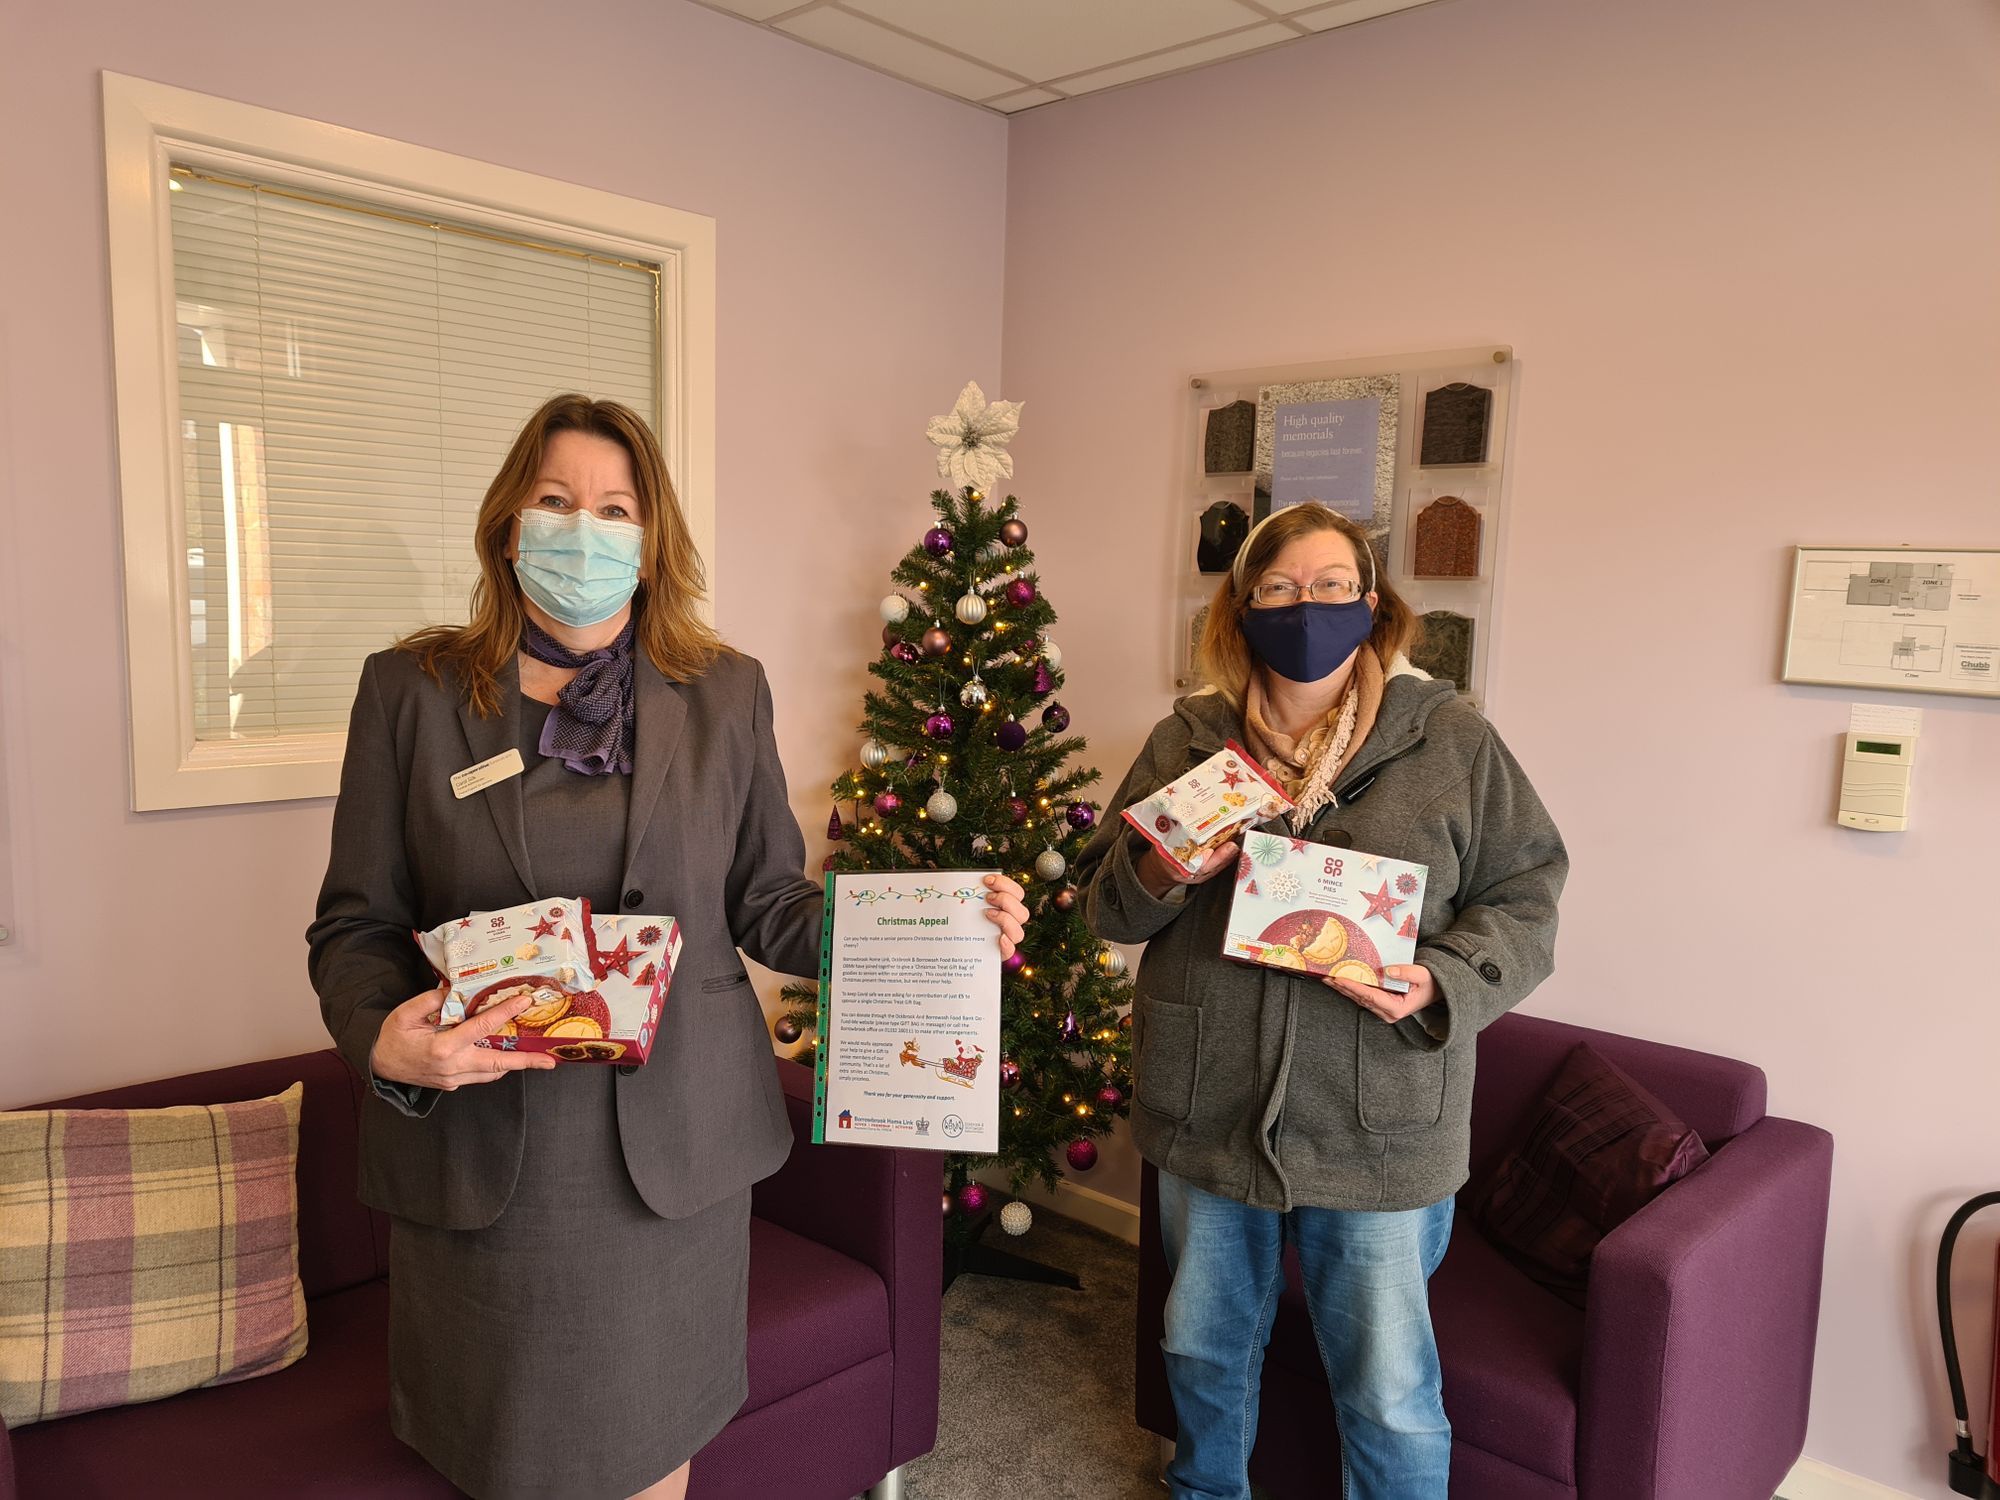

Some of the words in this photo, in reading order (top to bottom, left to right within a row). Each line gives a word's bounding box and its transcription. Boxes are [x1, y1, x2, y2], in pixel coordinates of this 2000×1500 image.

[1284, 415, 1307, 428] High
[1310, 412, 1344, 427] quality
[1282, 428, 1334, 441] memorials
[877, 917, 917, 925] Christmas
[919, 916, 949, 927] Appeal
